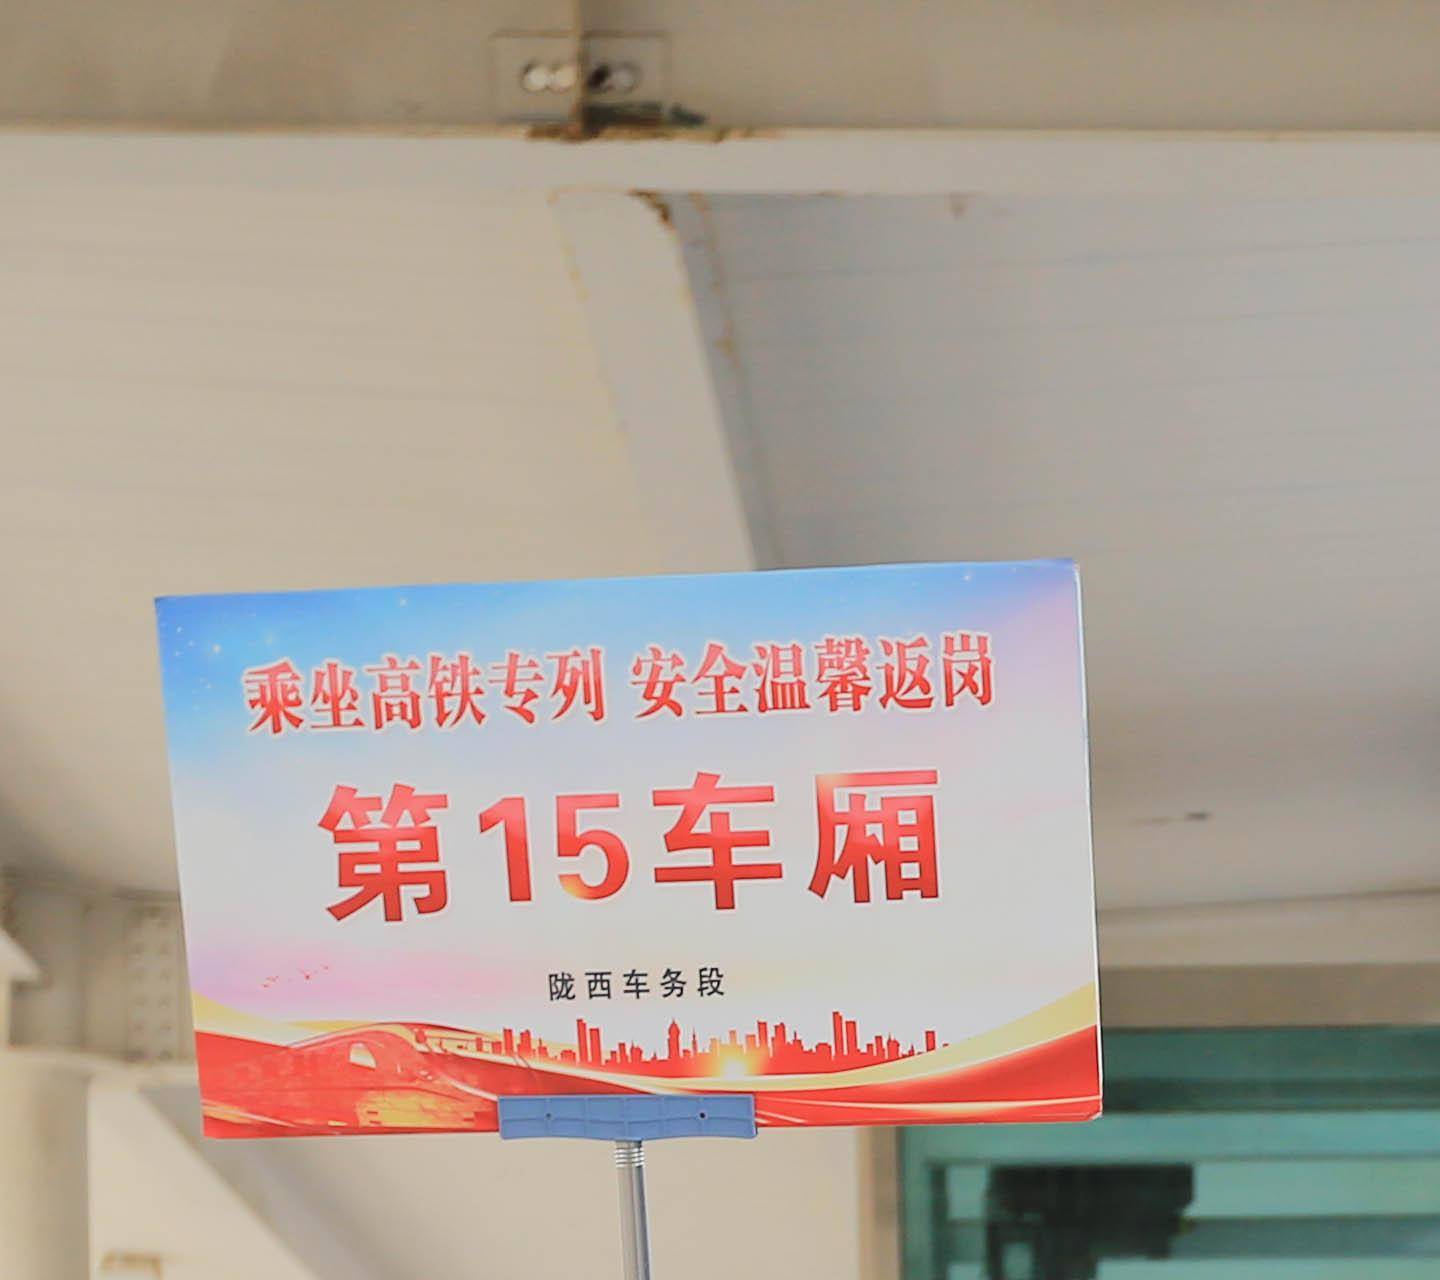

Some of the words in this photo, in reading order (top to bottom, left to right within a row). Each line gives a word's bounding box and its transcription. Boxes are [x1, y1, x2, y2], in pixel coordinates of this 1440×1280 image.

[241, 645, 607, 736] 乘坐高铁专列
[630, 630, 996, 723] 安全温馨返岗
[317, 768, 941, 923] 第15车厢
[547, 965, 726, 1002] 陇西车务段
